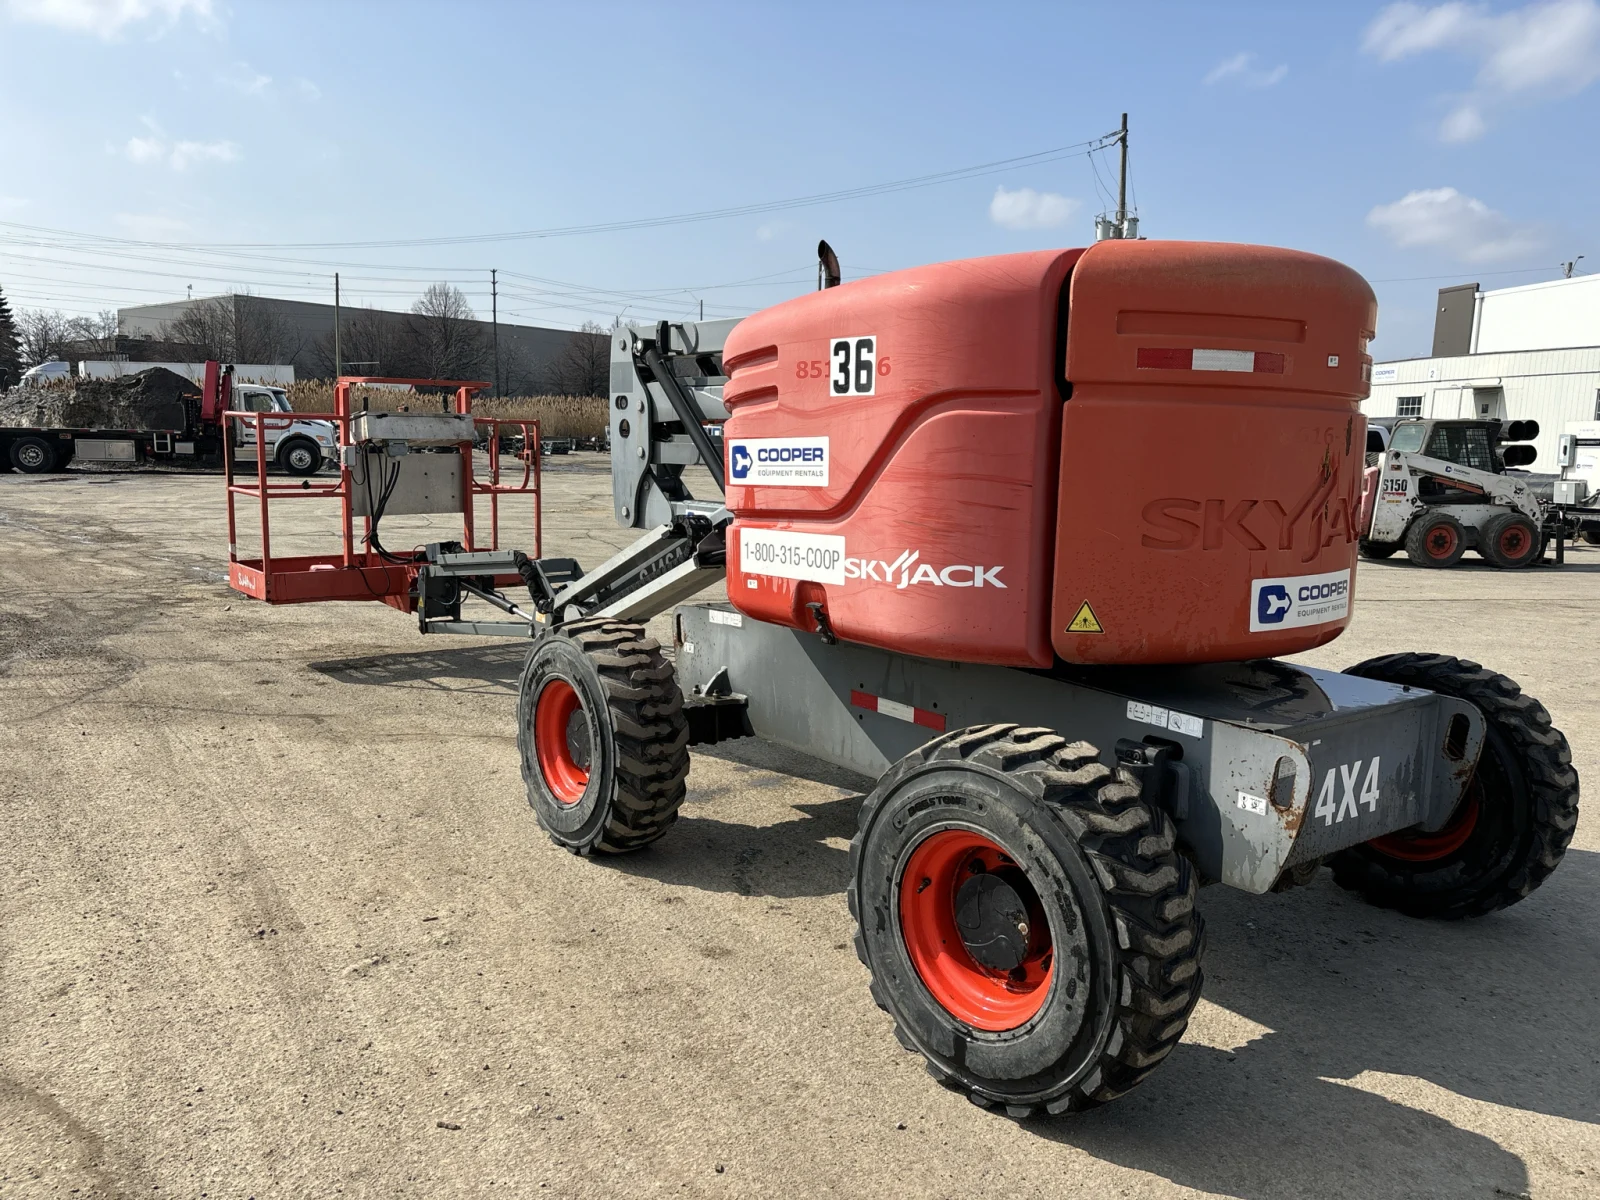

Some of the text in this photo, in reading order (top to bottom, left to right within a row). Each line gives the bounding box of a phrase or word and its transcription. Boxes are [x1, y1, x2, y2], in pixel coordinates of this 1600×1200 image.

[833, 338, 873, 394] 36
[758, 447, 824, 462] COOPER
[1383, 479, 1408, 492] S150
[745, 541, 840, 570] 1-800-315-COOP
[844, 548, 1008, 590] SKYJACK
[1298, 579, 1348, 601] COOPER
[1297, 606, 1330, 617] EQUIPMENT
[1314, 755, 1381, 827] 4X4
